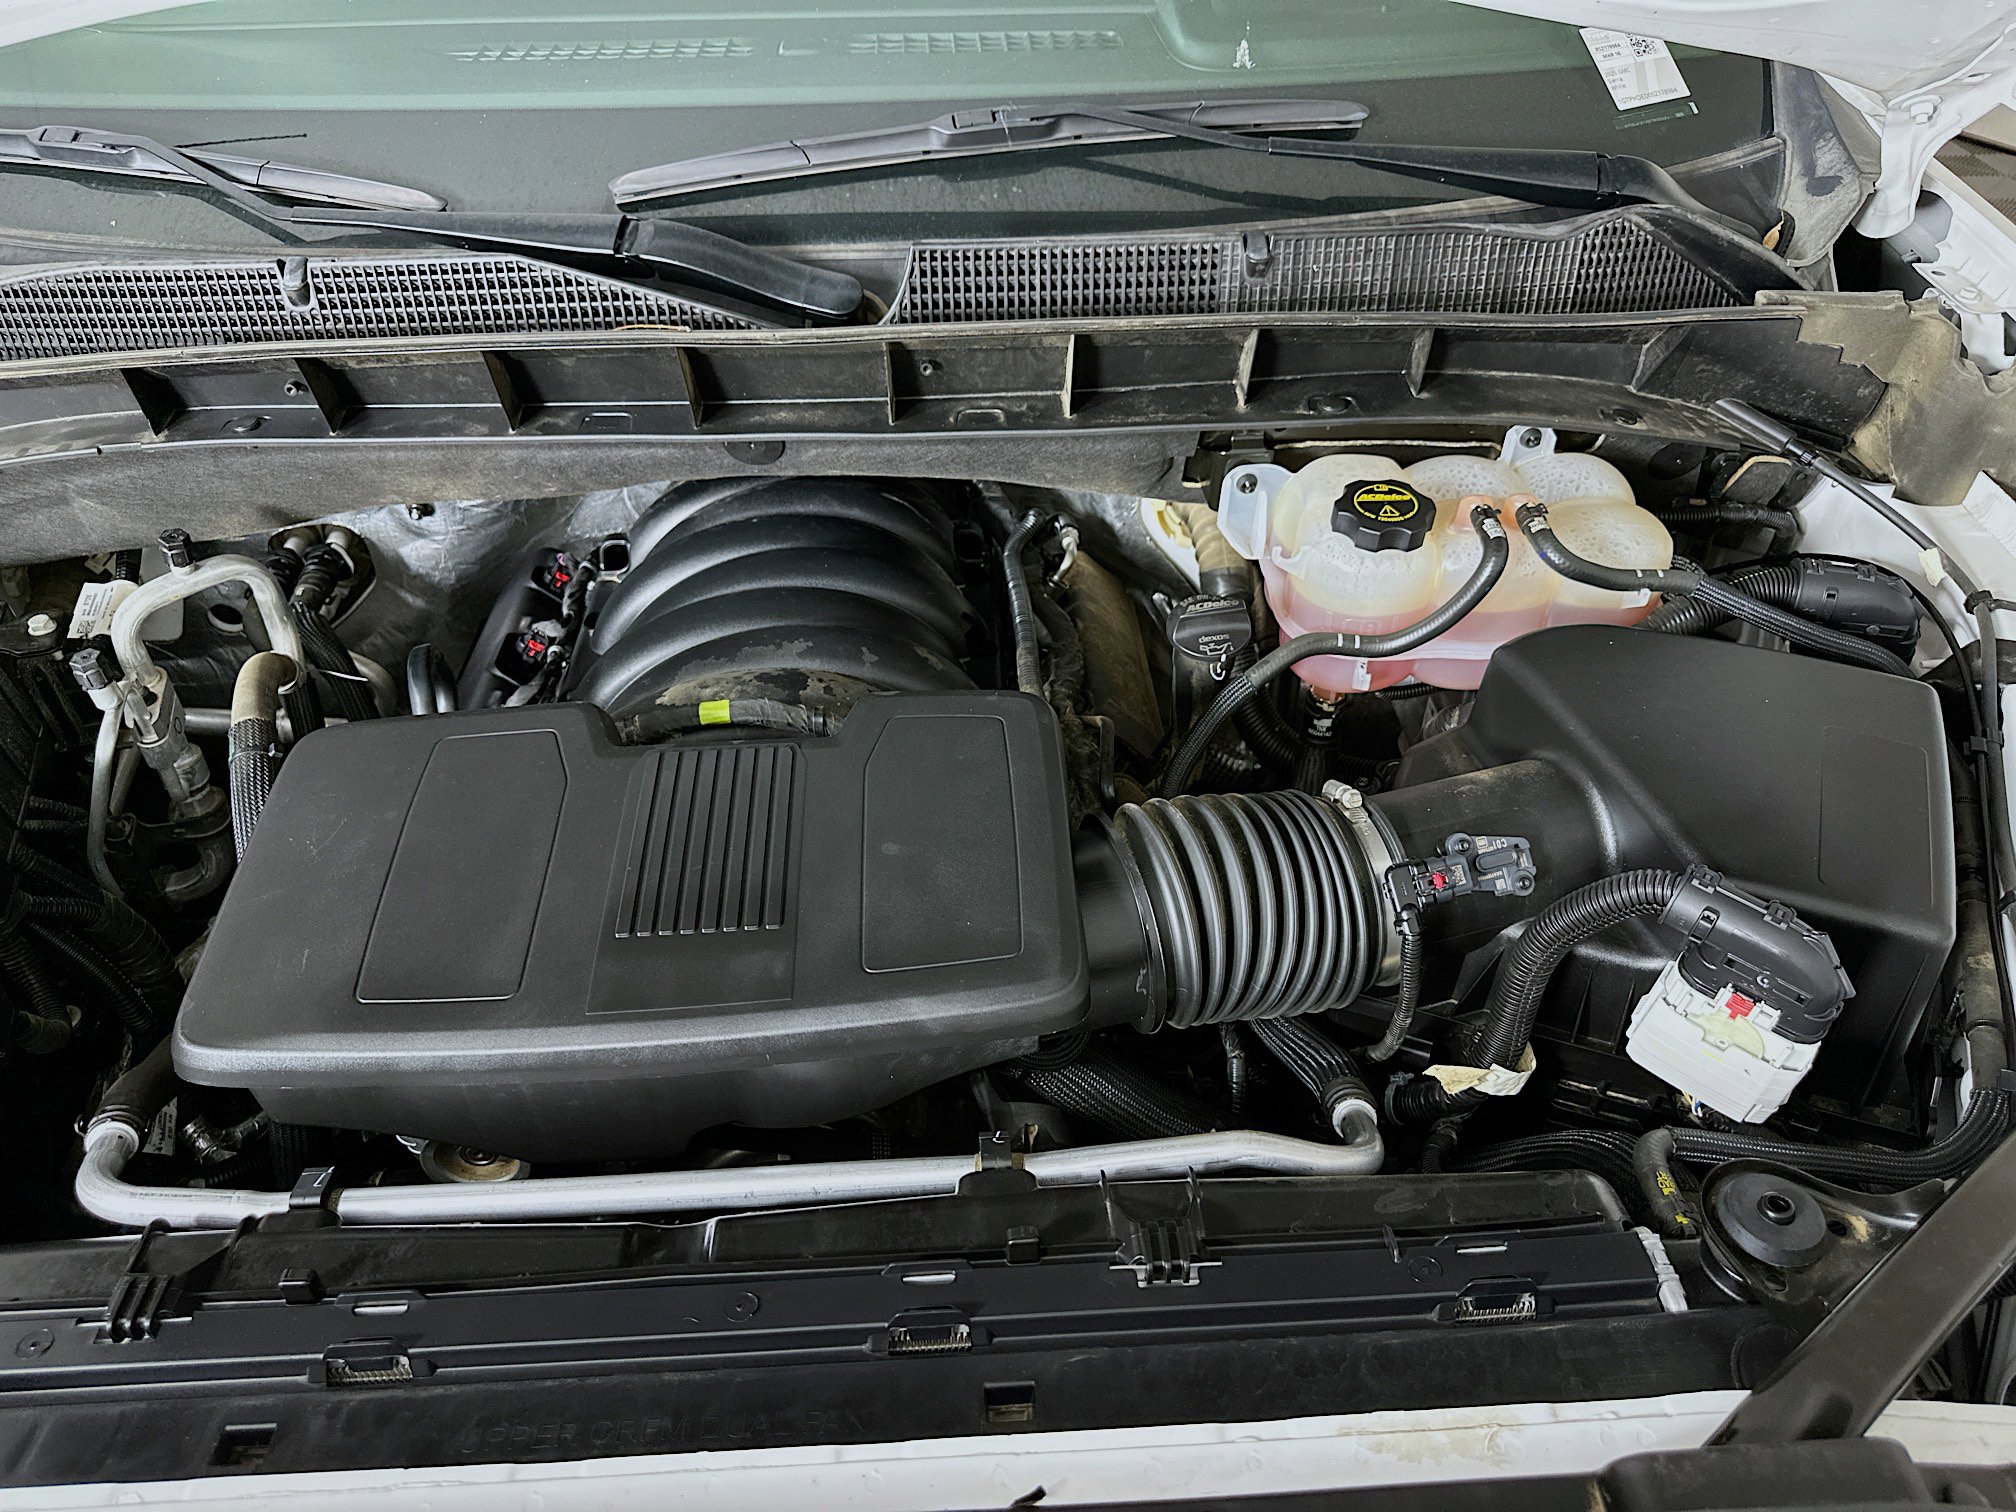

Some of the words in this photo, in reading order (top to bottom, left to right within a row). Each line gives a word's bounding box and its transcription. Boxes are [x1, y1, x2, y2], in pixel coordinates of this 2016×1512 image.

[1611, 83, 1627, 91] White
[1356, 493, 1412, 502] ACDelco
[1180, 596, 1195, 608] SAE
[1185, 599, 1240, 613] ACDelco
[1199, 633, 1230, 644] dexos
[1492, 838, 1507, 849] C01
[460, 1422, 578, 1453] UPPER
[700, 1412, 793, 1440] DUAL
